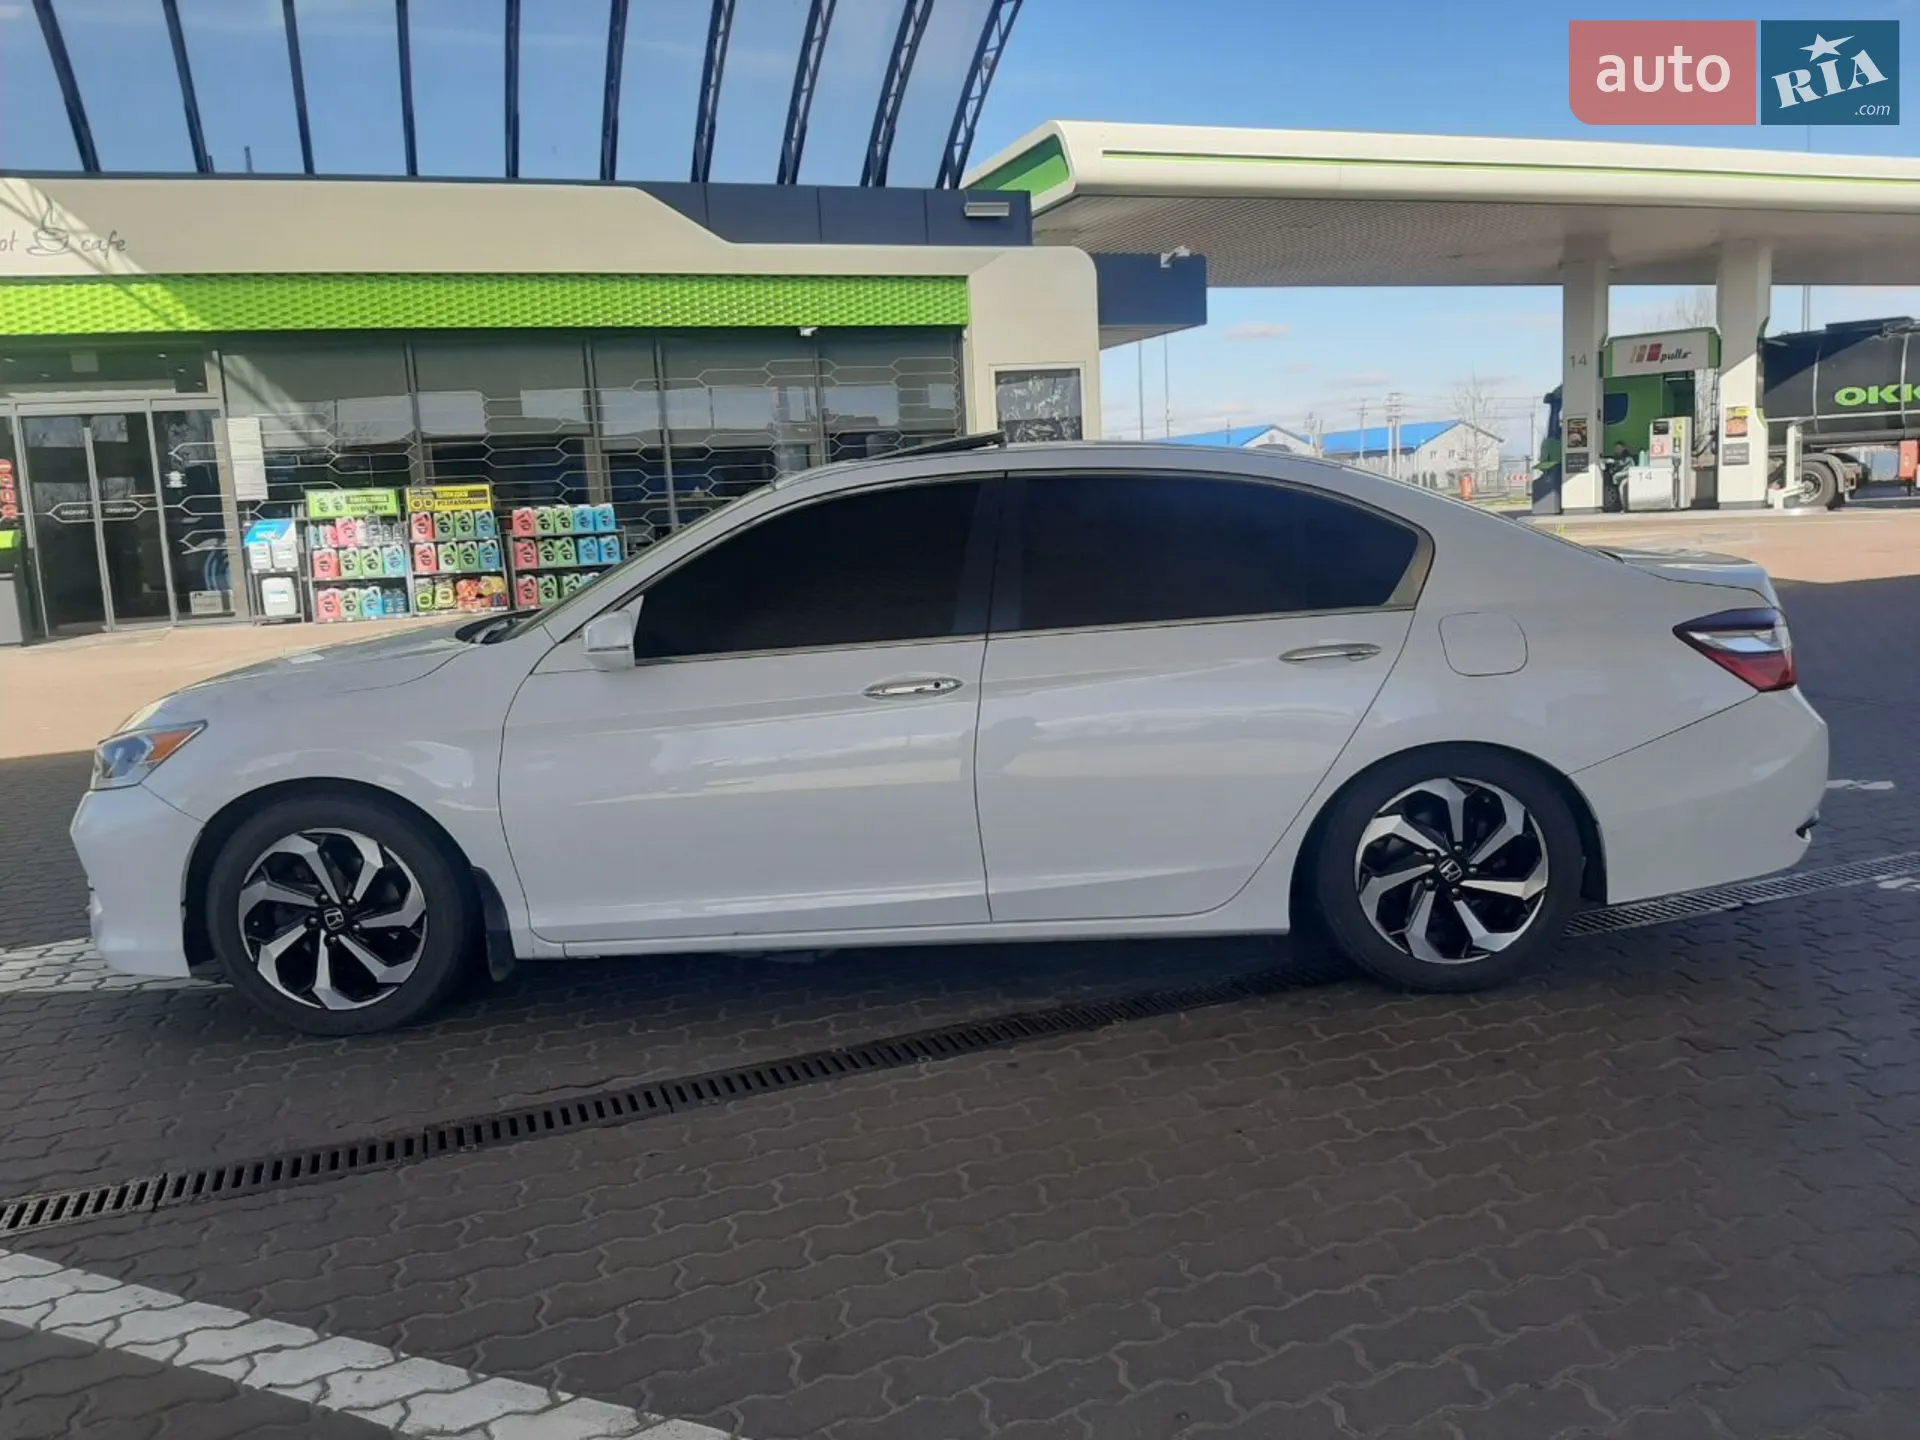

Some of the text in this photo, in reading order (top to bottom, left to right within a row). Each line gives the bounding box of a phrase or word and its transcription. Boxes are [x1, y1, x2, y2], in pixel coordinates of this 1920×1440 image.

[80, 229, 126, 260] cafe
[1570, 352, 1588, 368] 14
[1638, 470, 1653, 481] 14
